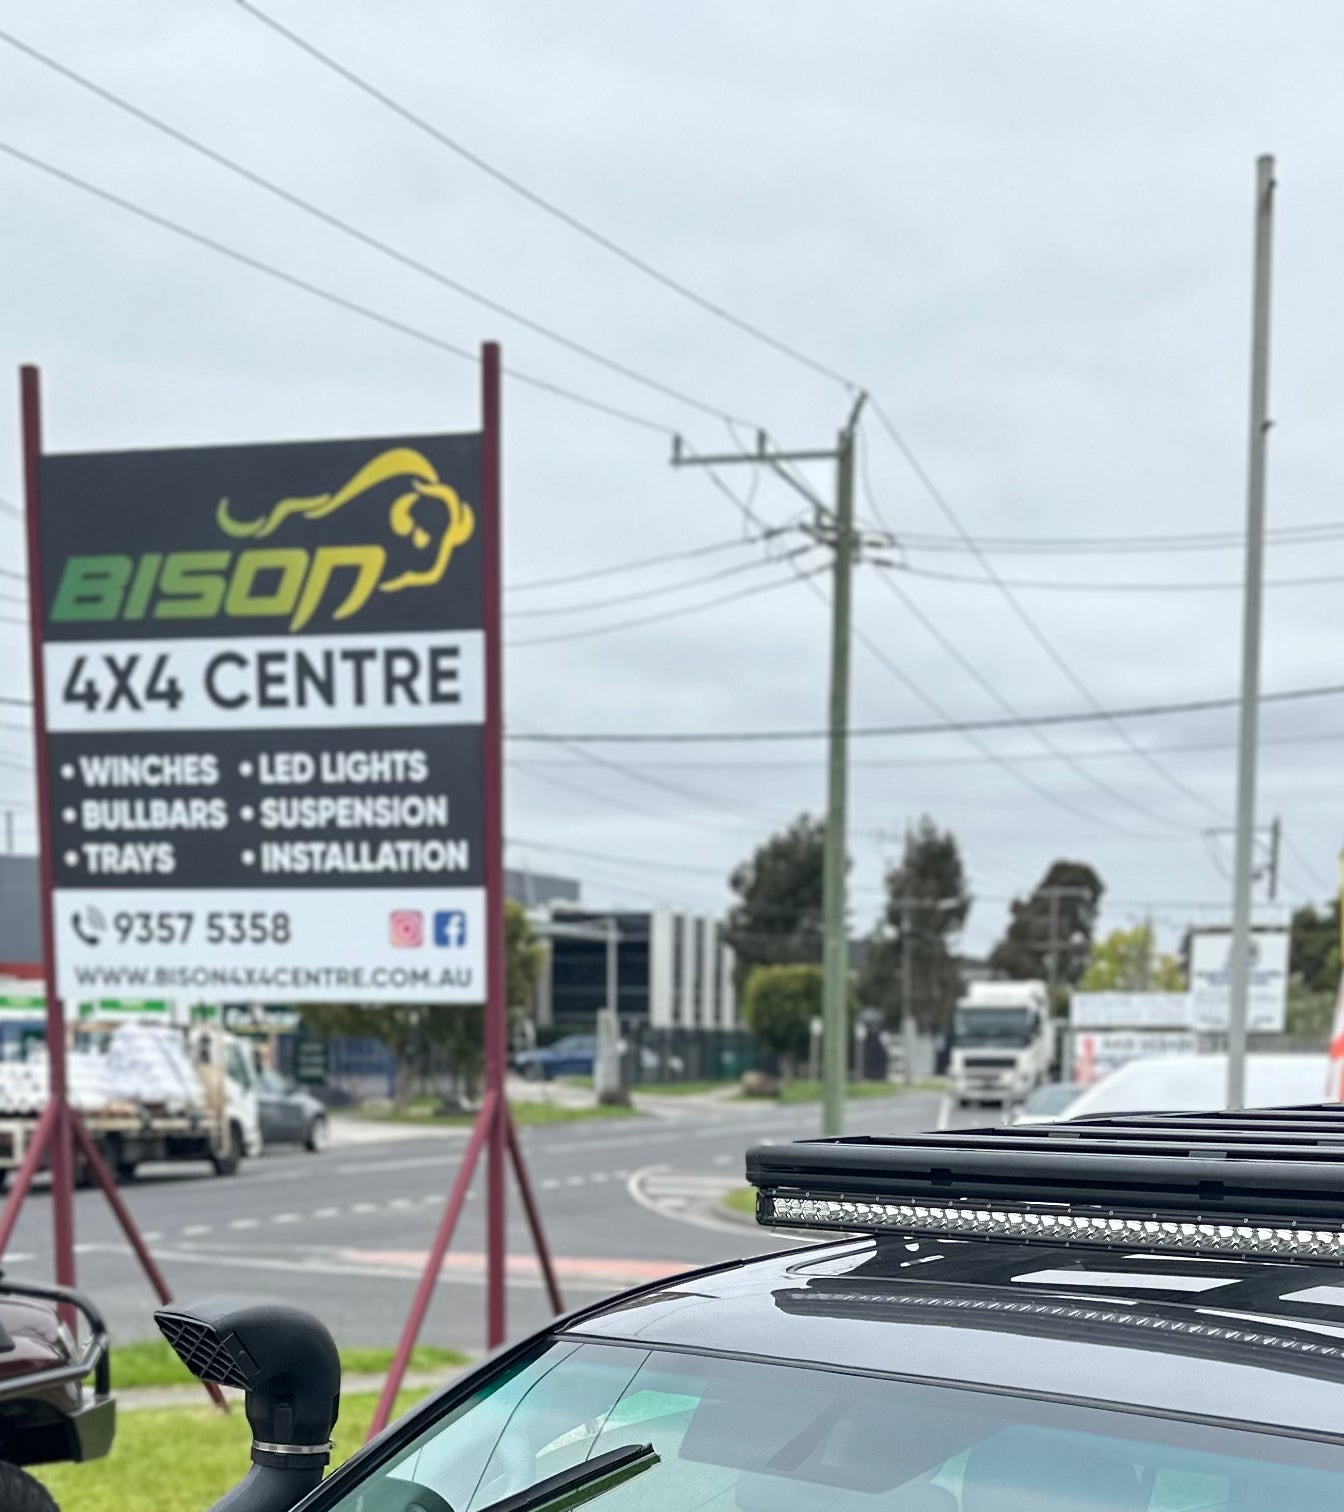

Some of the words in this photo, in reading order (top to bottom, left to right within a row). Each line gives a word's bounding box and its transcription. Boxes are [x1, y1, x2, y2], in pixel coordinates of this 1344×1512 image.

[50, 545, 386, 632] BISON
[62, 653, 184, 712] 4X4
[204, 646, 462, 710] CENTRE
[79, 755, 219, 787] WINCHES
[259, 752, 315, 784] LED
[321, 750, 428, 784] LIGHTS
[82, 798, 228, 830] BULLBARS
[260, 795, 448, 828] SUSPENSION
[83, 842, 176, 874] TRAYS
[260, 840, 469, 872] INSTALLATION
[112, 911, 194, 945] 9357
[206, 911, 291, 944] 5358
[74, 964, 472, 992] WWW.BISON4X4CENTRE.COM.AU
